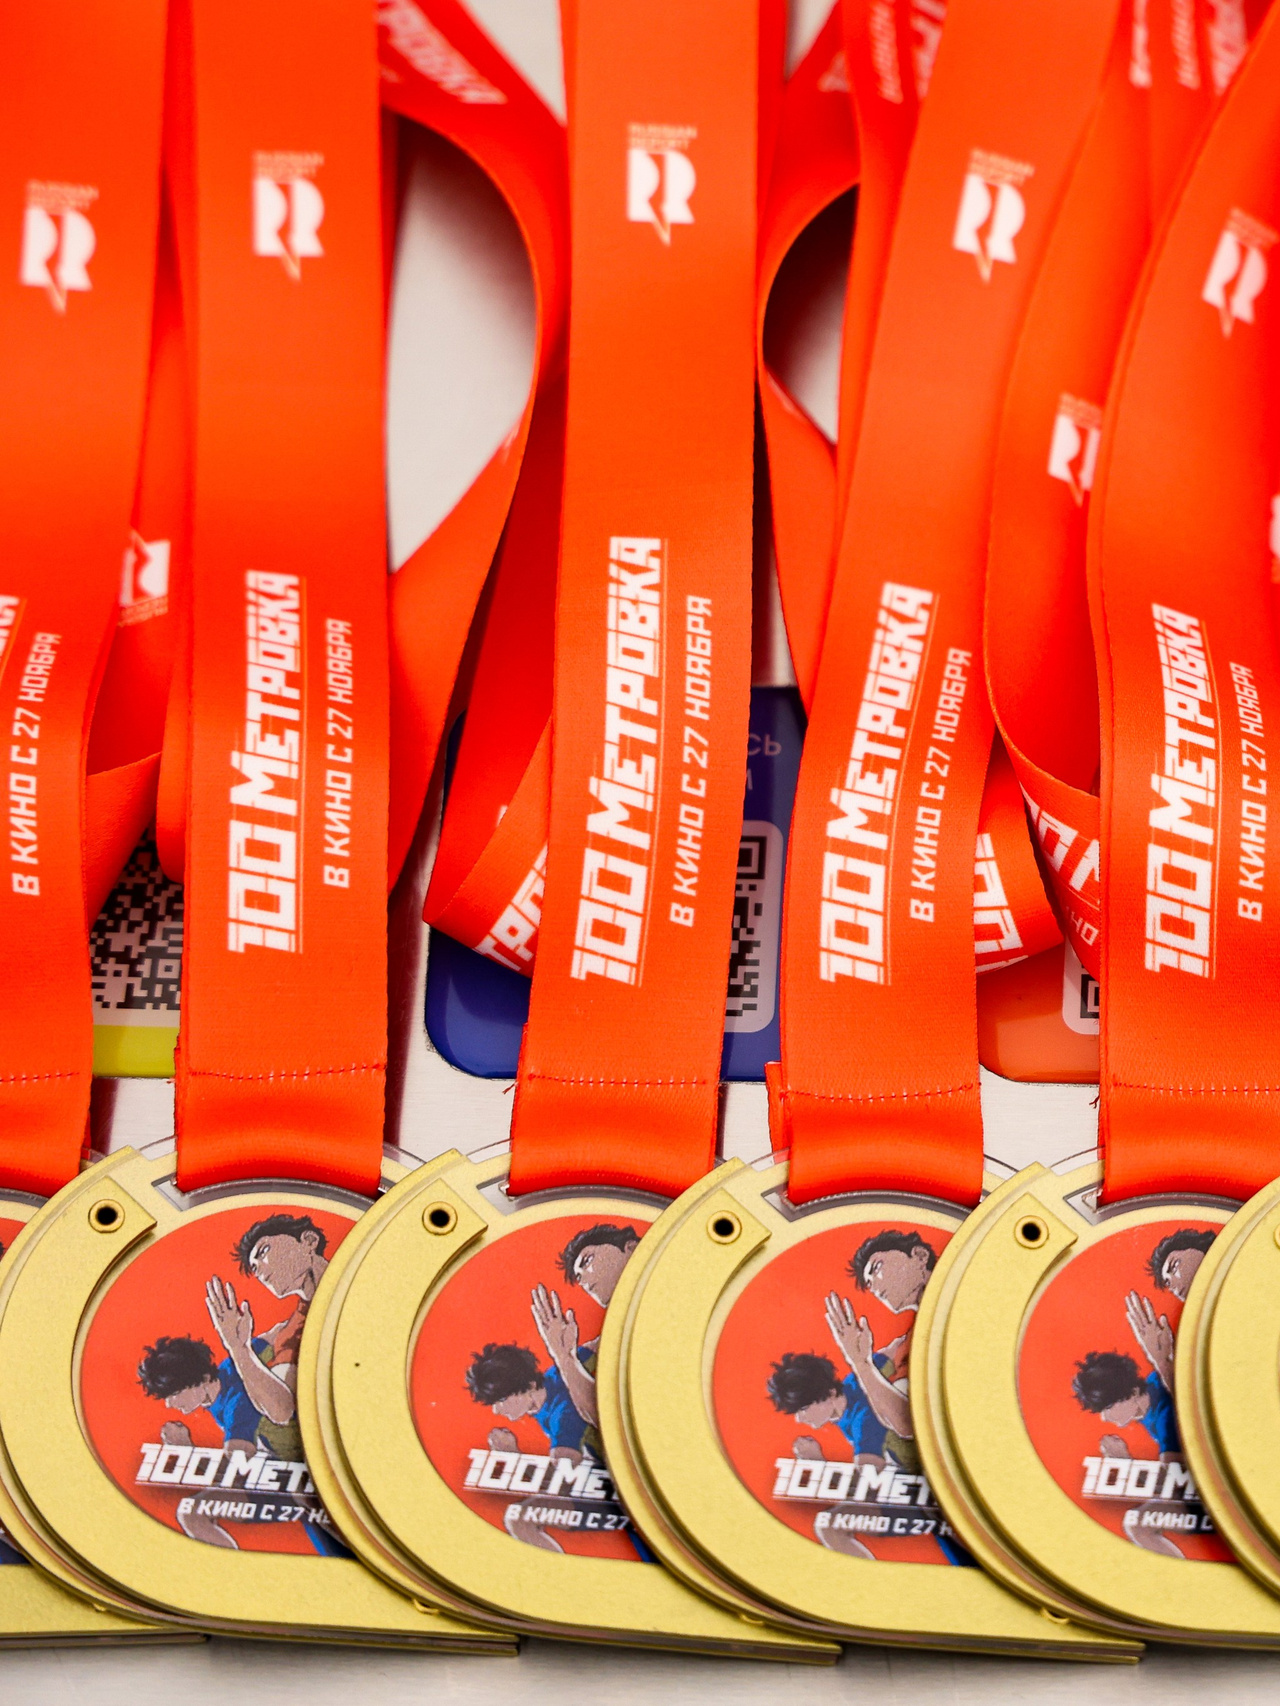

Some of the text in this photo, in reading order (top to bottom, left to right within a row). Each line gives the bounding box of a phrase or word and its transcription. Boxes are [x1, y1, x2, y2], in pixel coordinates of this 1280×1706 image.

[9, 631, 62, 896] В КИНО С 27 НОЯБРЯ
[323, 618, 353, 889] В КИНО С 27 НОЯБРЯ
[669, 594, 713, 928] В КИНО С 27 НОЯБРЯ
[909, 647, 971, 923] В КИНО С 27 НОЯБРЯ
[1229, 662, 1267, 922] В КИНО С 27 НОЯБРЯ
[228, 820, 300, 952] 100
[570, 847, 647, 985] 100
[820, 851, 886, 984] 100
[1145, 843, 1212, 977] 100
[136, 1443, 224, 1485] 100
[178, 1498, 195, 1514] В
[198, 1500, 256, 1519] КИНО
[260, 1505, 275, 1520] С
[278, 1506, 304, 1522] 27
[464, 1449, 551, 1492] 100
[505, 1504, 630, 1530] В КИНО С 27
[773, 1458, 855, 1499] 100
[815, 1512, 831, 1527] В
[833, 1514, 889, 1532] КИНО
[893, 1518, 907, 1533] С
[910, 1519, 936, 1534] 27
[1082, 1457, 1162, 1497] 100
[1124, 1510, 1139, 1525] В
[1142, 1511, 1196, 1529] КИНО
